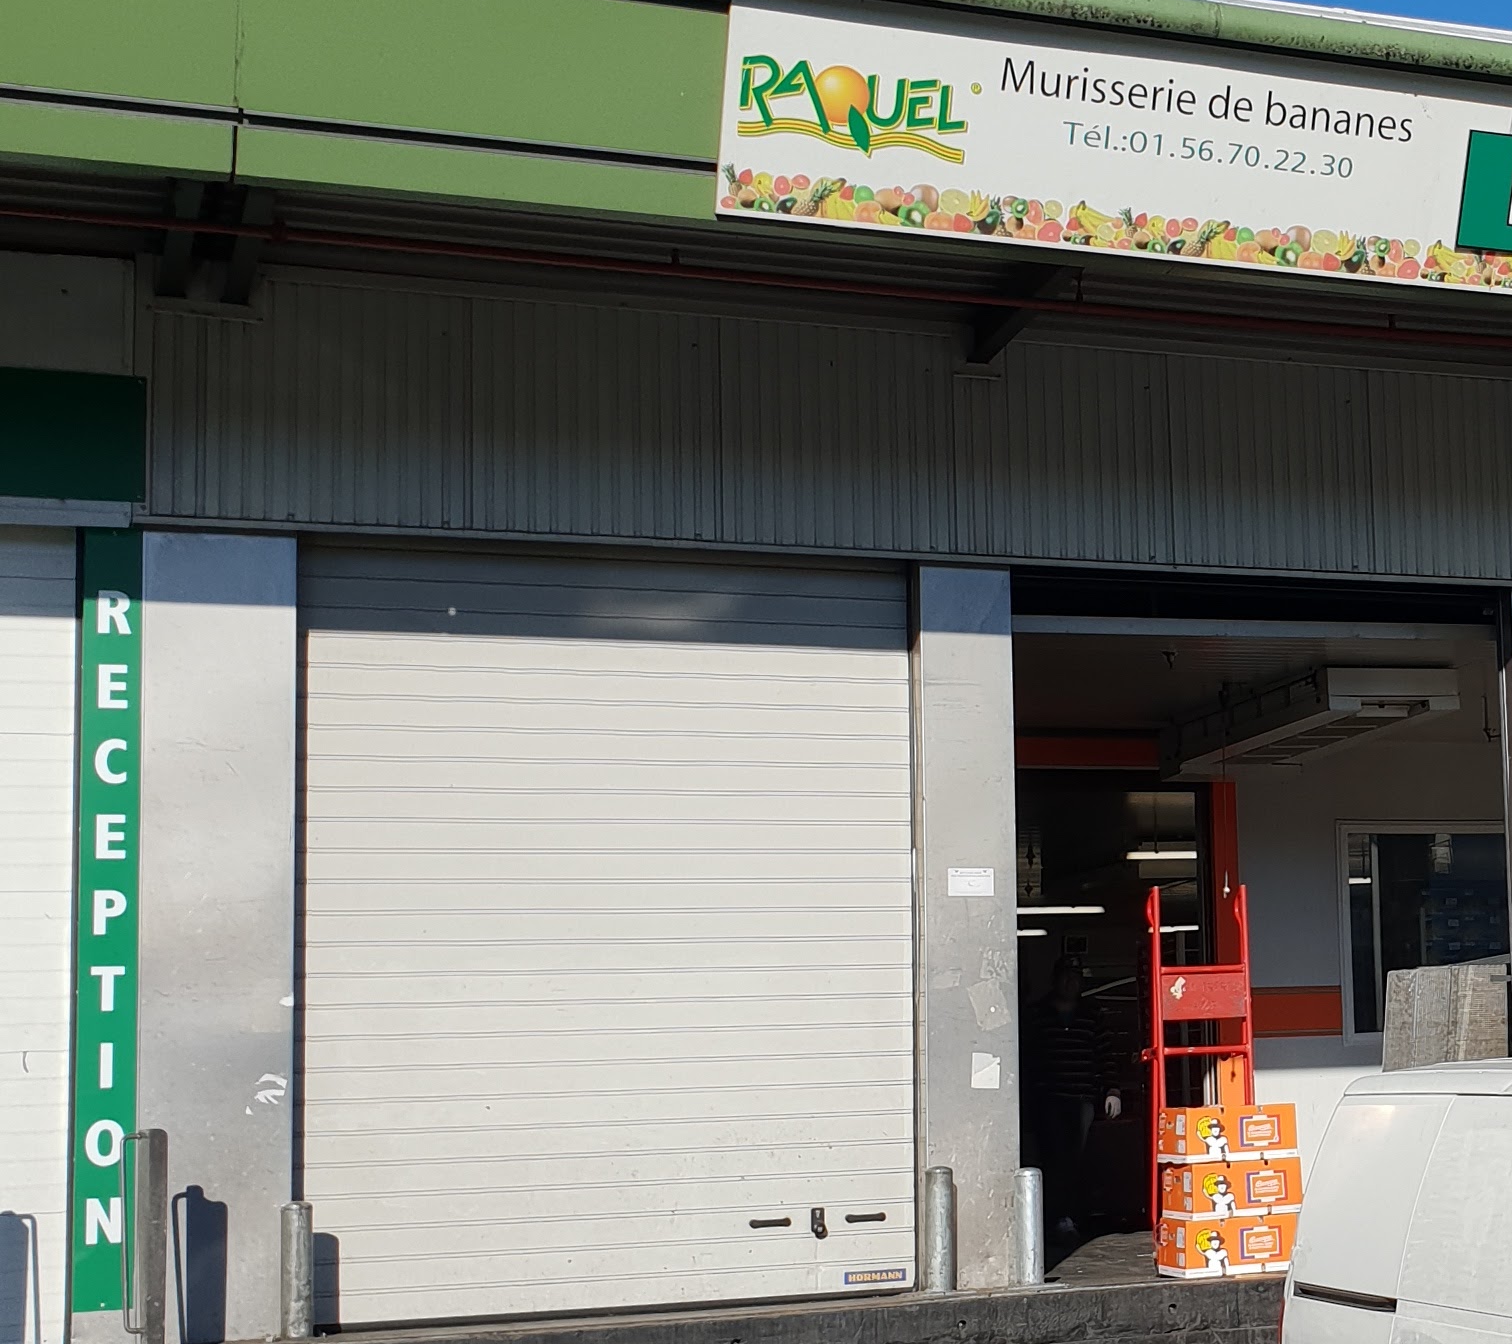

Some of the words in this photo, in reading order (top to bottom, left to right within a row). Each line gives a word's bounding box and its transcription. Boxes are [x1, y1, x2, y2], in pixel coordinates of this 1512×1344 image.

[1000, 57, 1196, 116] Murisserie
[1207, 83, 1254, 124] de
[1265, 91, 1414, 143] bananes
[1063, 120, 1354, 180] Tél.:01.56.70.22.30
[84, 589, 132, 1246] RECEPTION
